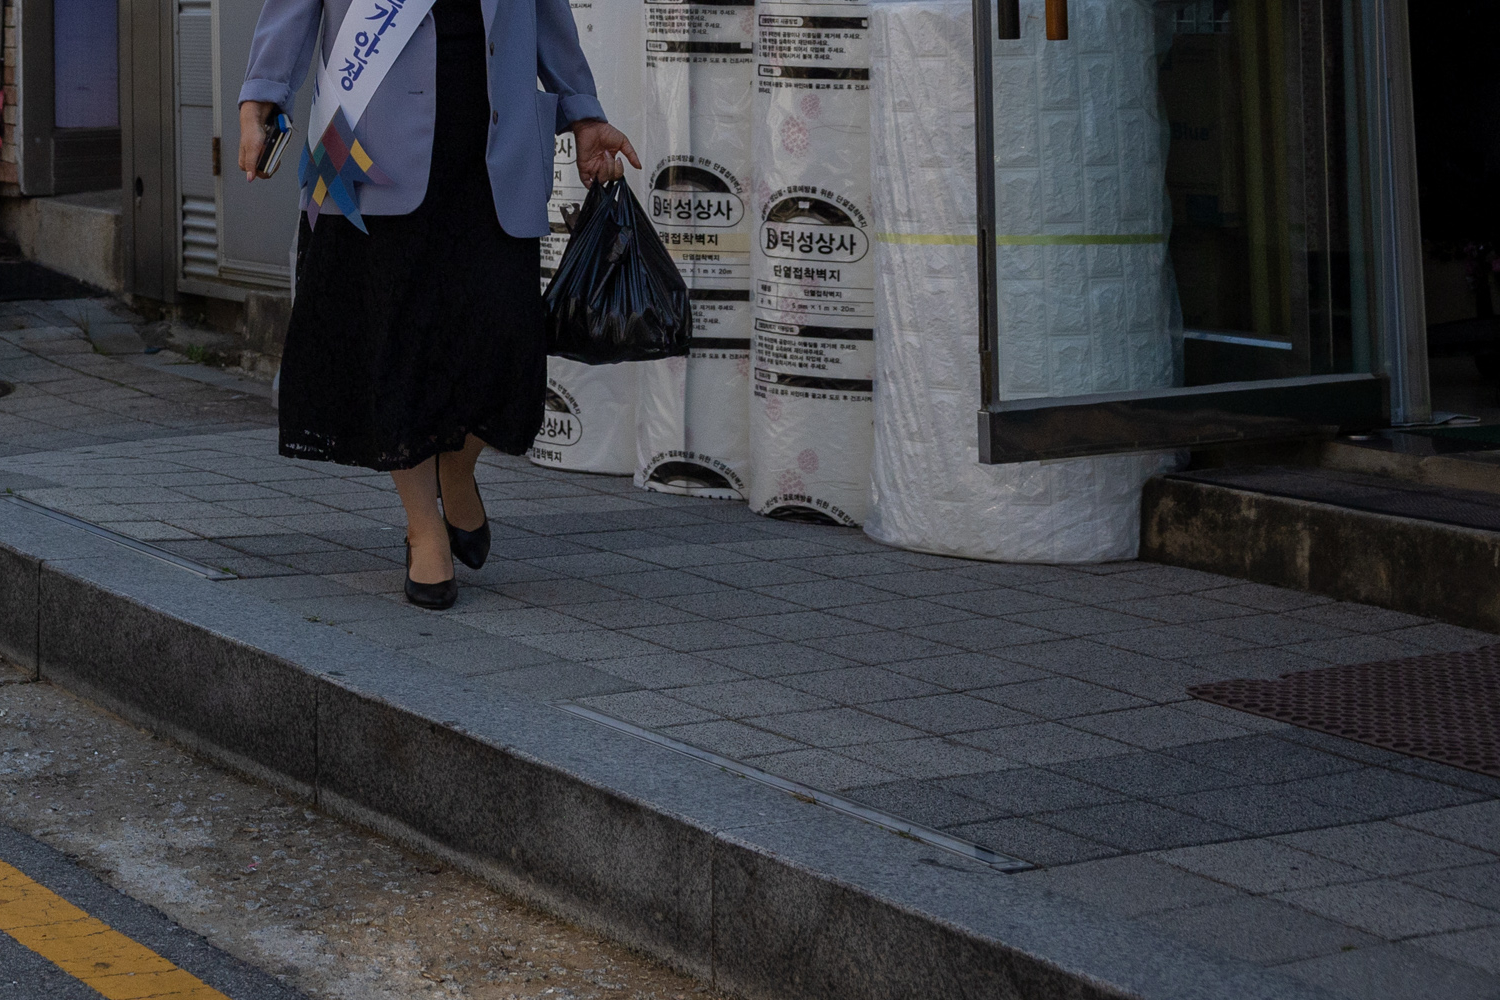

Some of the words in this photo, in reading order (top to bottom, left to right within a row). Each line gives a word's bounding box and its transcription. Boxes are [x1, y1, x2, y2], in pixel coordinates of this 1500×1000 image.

[662, 197, 734, 221] 덕성상사
[779, 230, 857, 256] 덕성상사
[773, 264, 841, 283] 단열접착벽지
